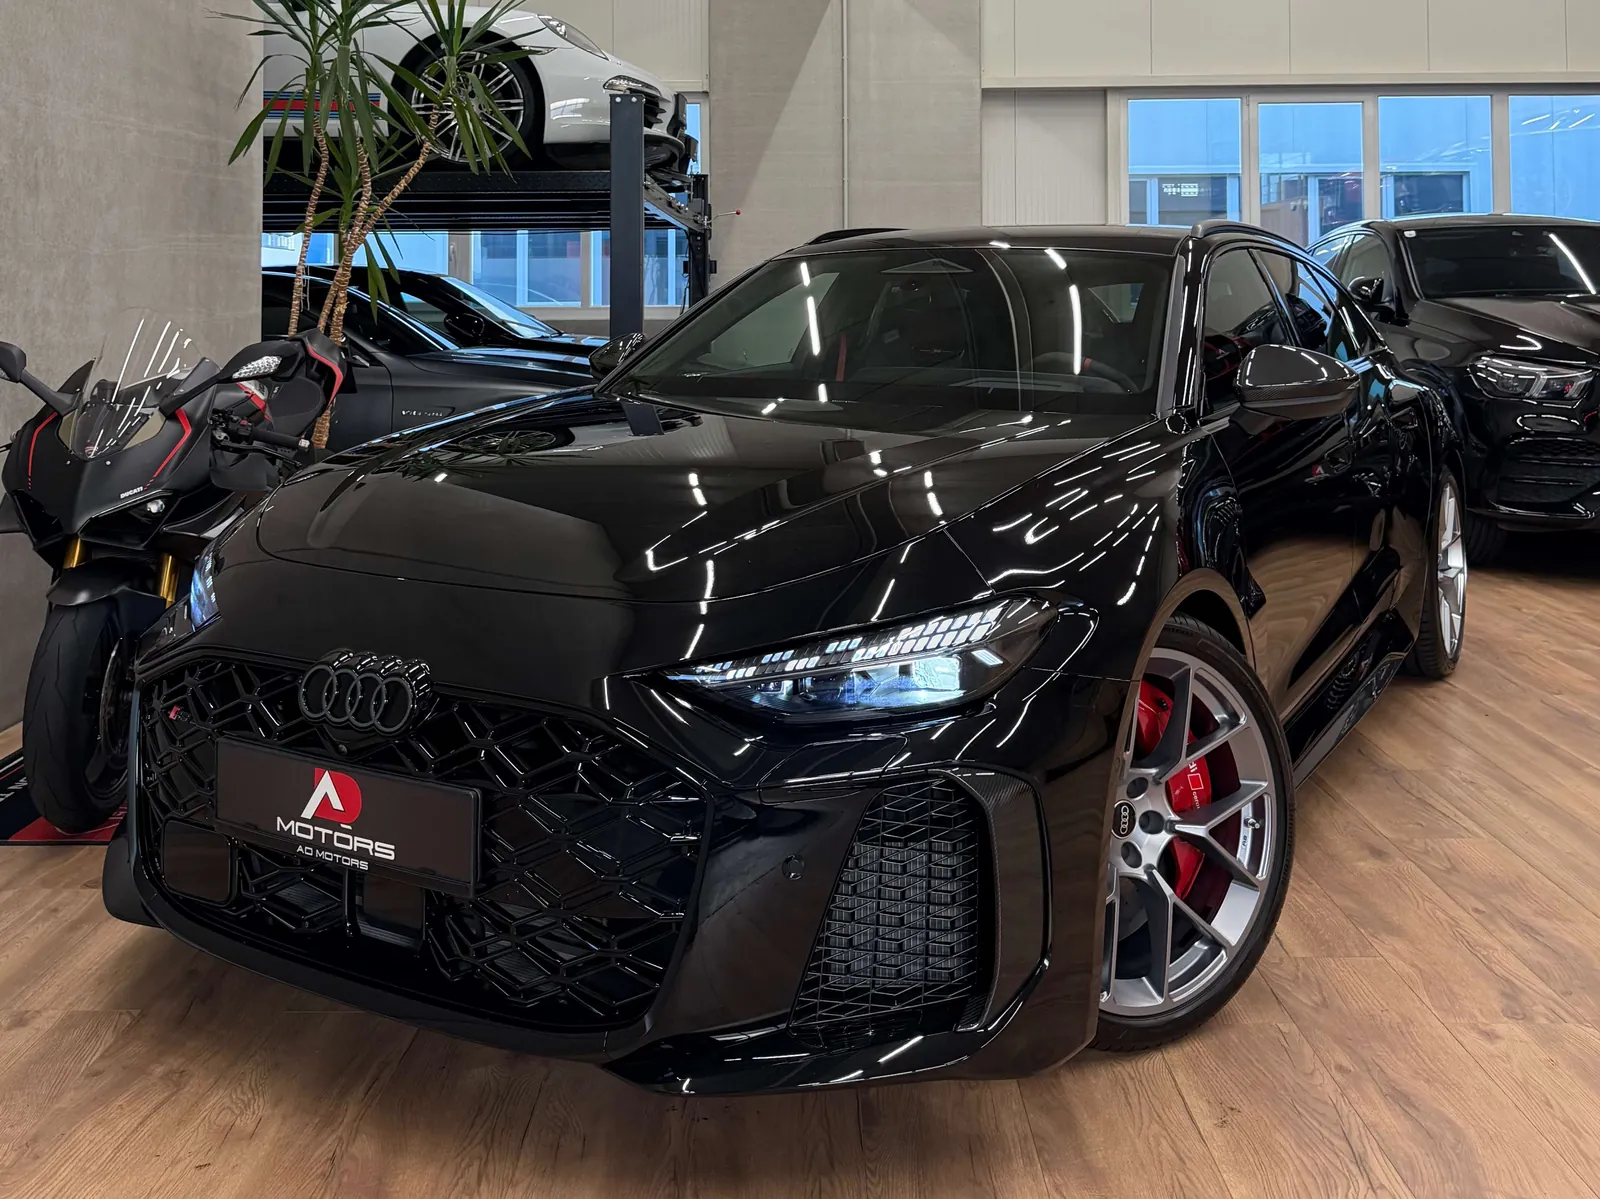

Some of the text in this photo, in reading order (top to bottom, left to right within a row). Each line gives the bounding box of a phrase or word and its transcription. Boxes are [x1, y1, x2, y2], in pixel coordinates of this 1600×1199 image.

[120, 486, 143, 499] DUCATI
[276, 816, 396, 861] MOTORS
[316, 849, 369, 871] MOTORS
